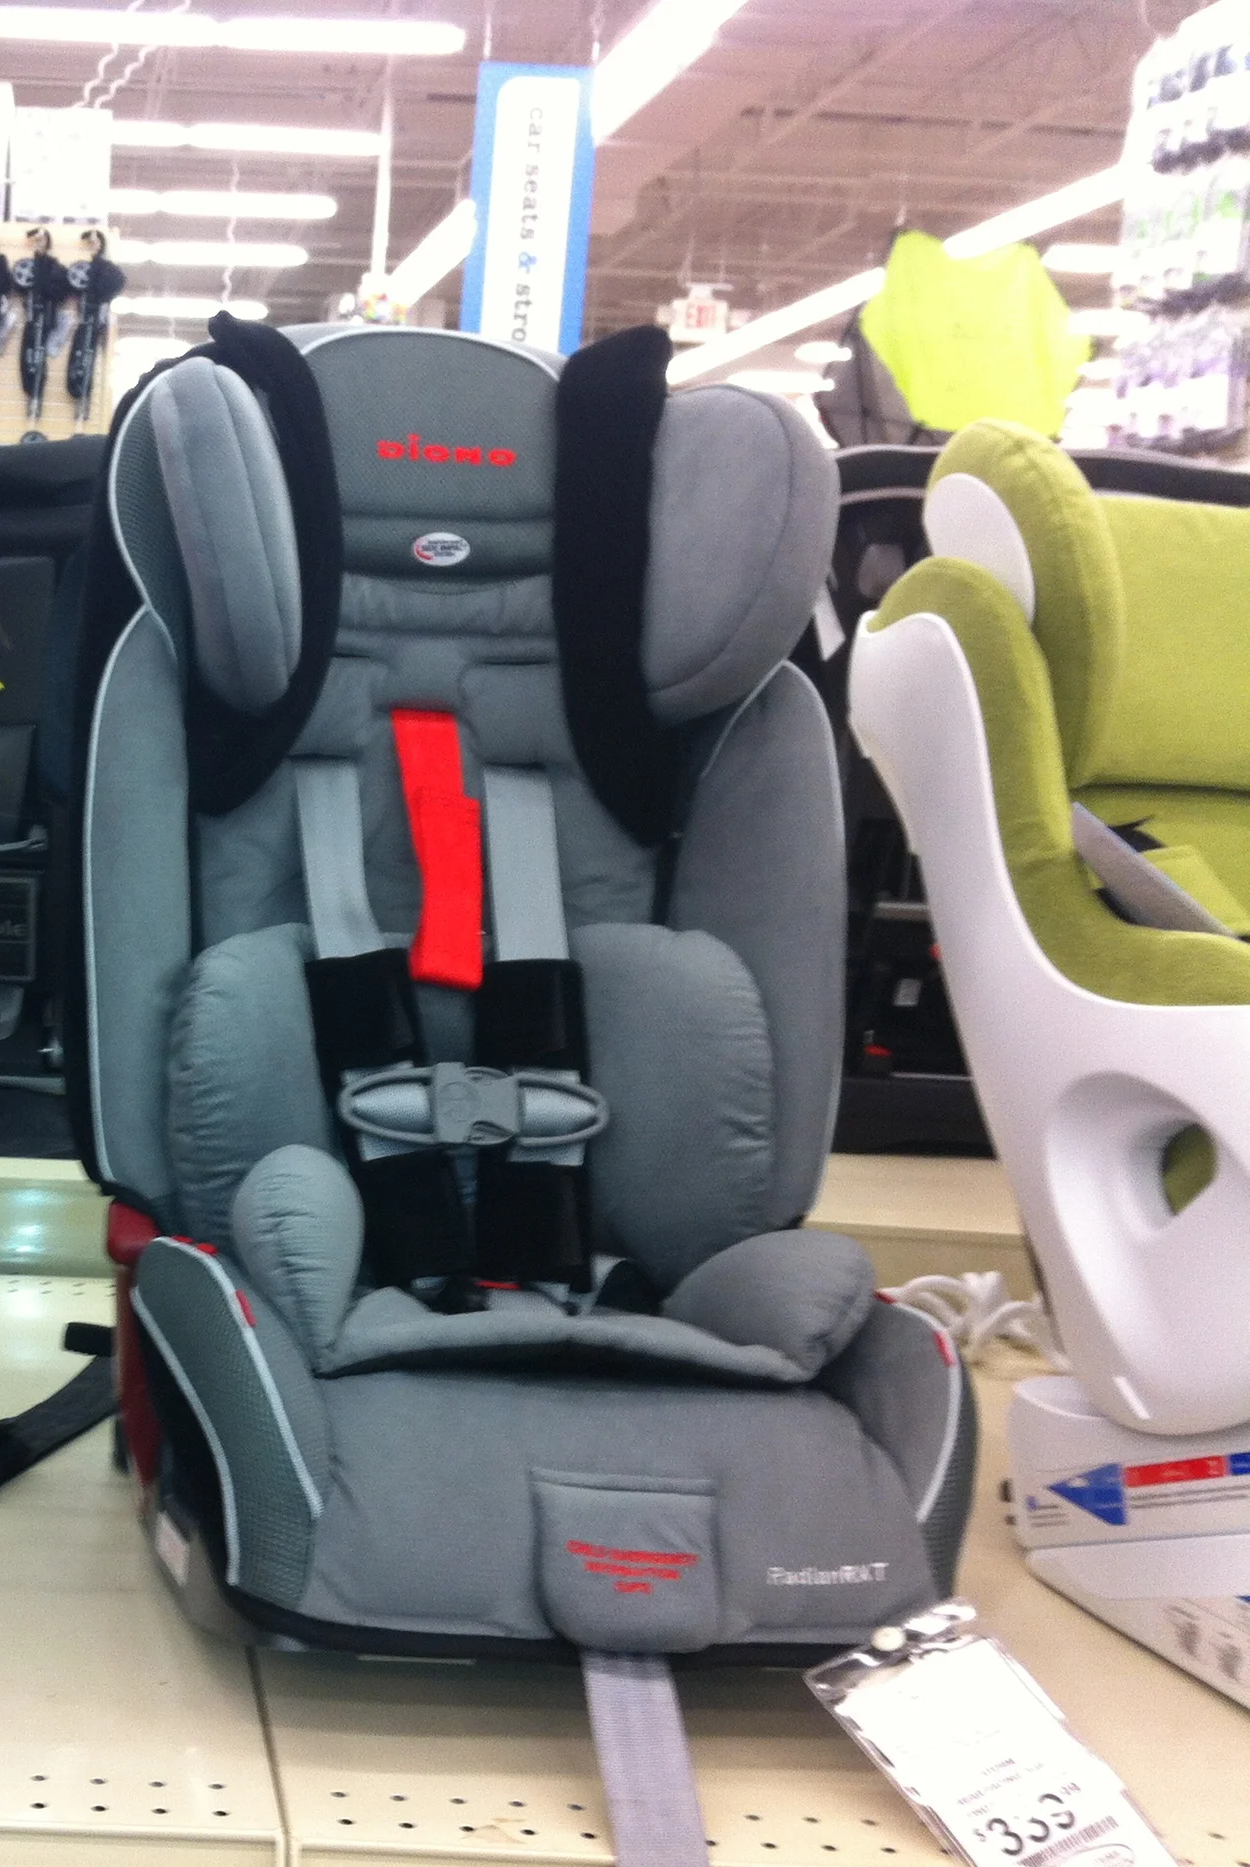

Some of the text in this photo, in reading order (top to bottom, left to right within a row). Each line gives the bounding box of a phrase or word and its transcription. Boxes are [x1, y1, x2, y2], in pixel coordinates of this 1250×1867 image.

[511, 107, 543, 343] car seats & stro
